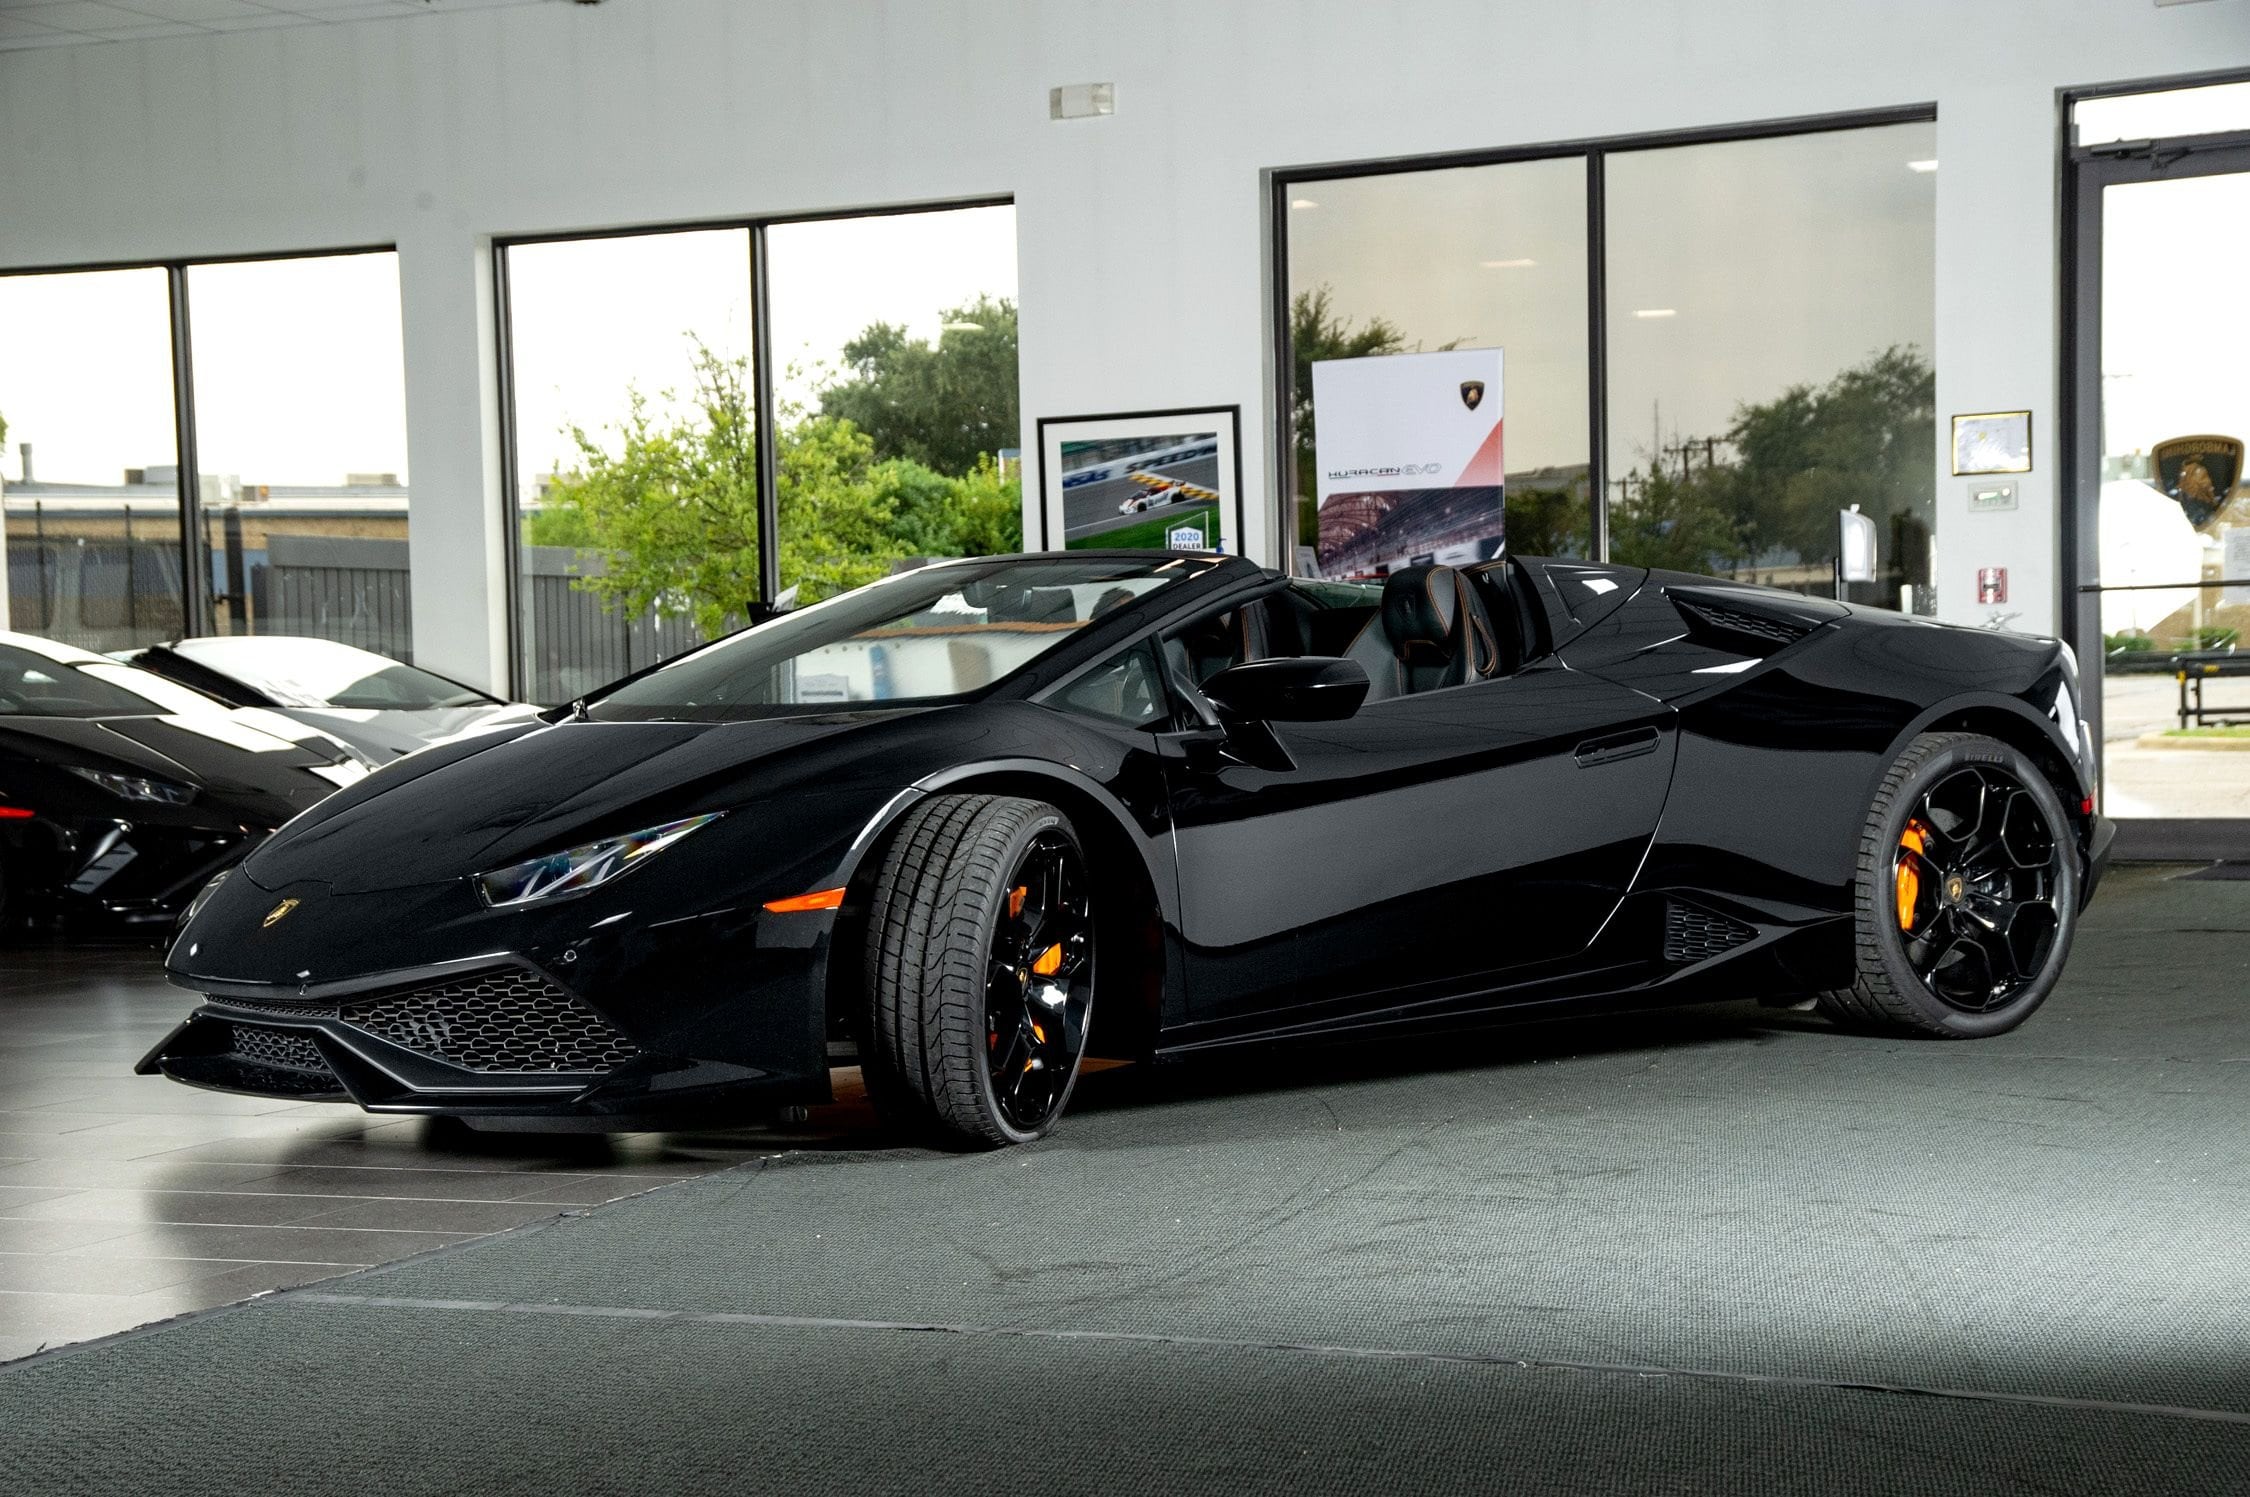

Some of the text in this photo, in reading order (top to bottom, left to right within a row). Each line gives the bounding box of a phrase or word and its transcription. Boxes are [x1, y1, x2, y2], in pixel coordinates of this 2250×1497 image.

[1328, 462, 1442, 478] HURACAN EVO
[1174, 532, 1200, 541] 2020
